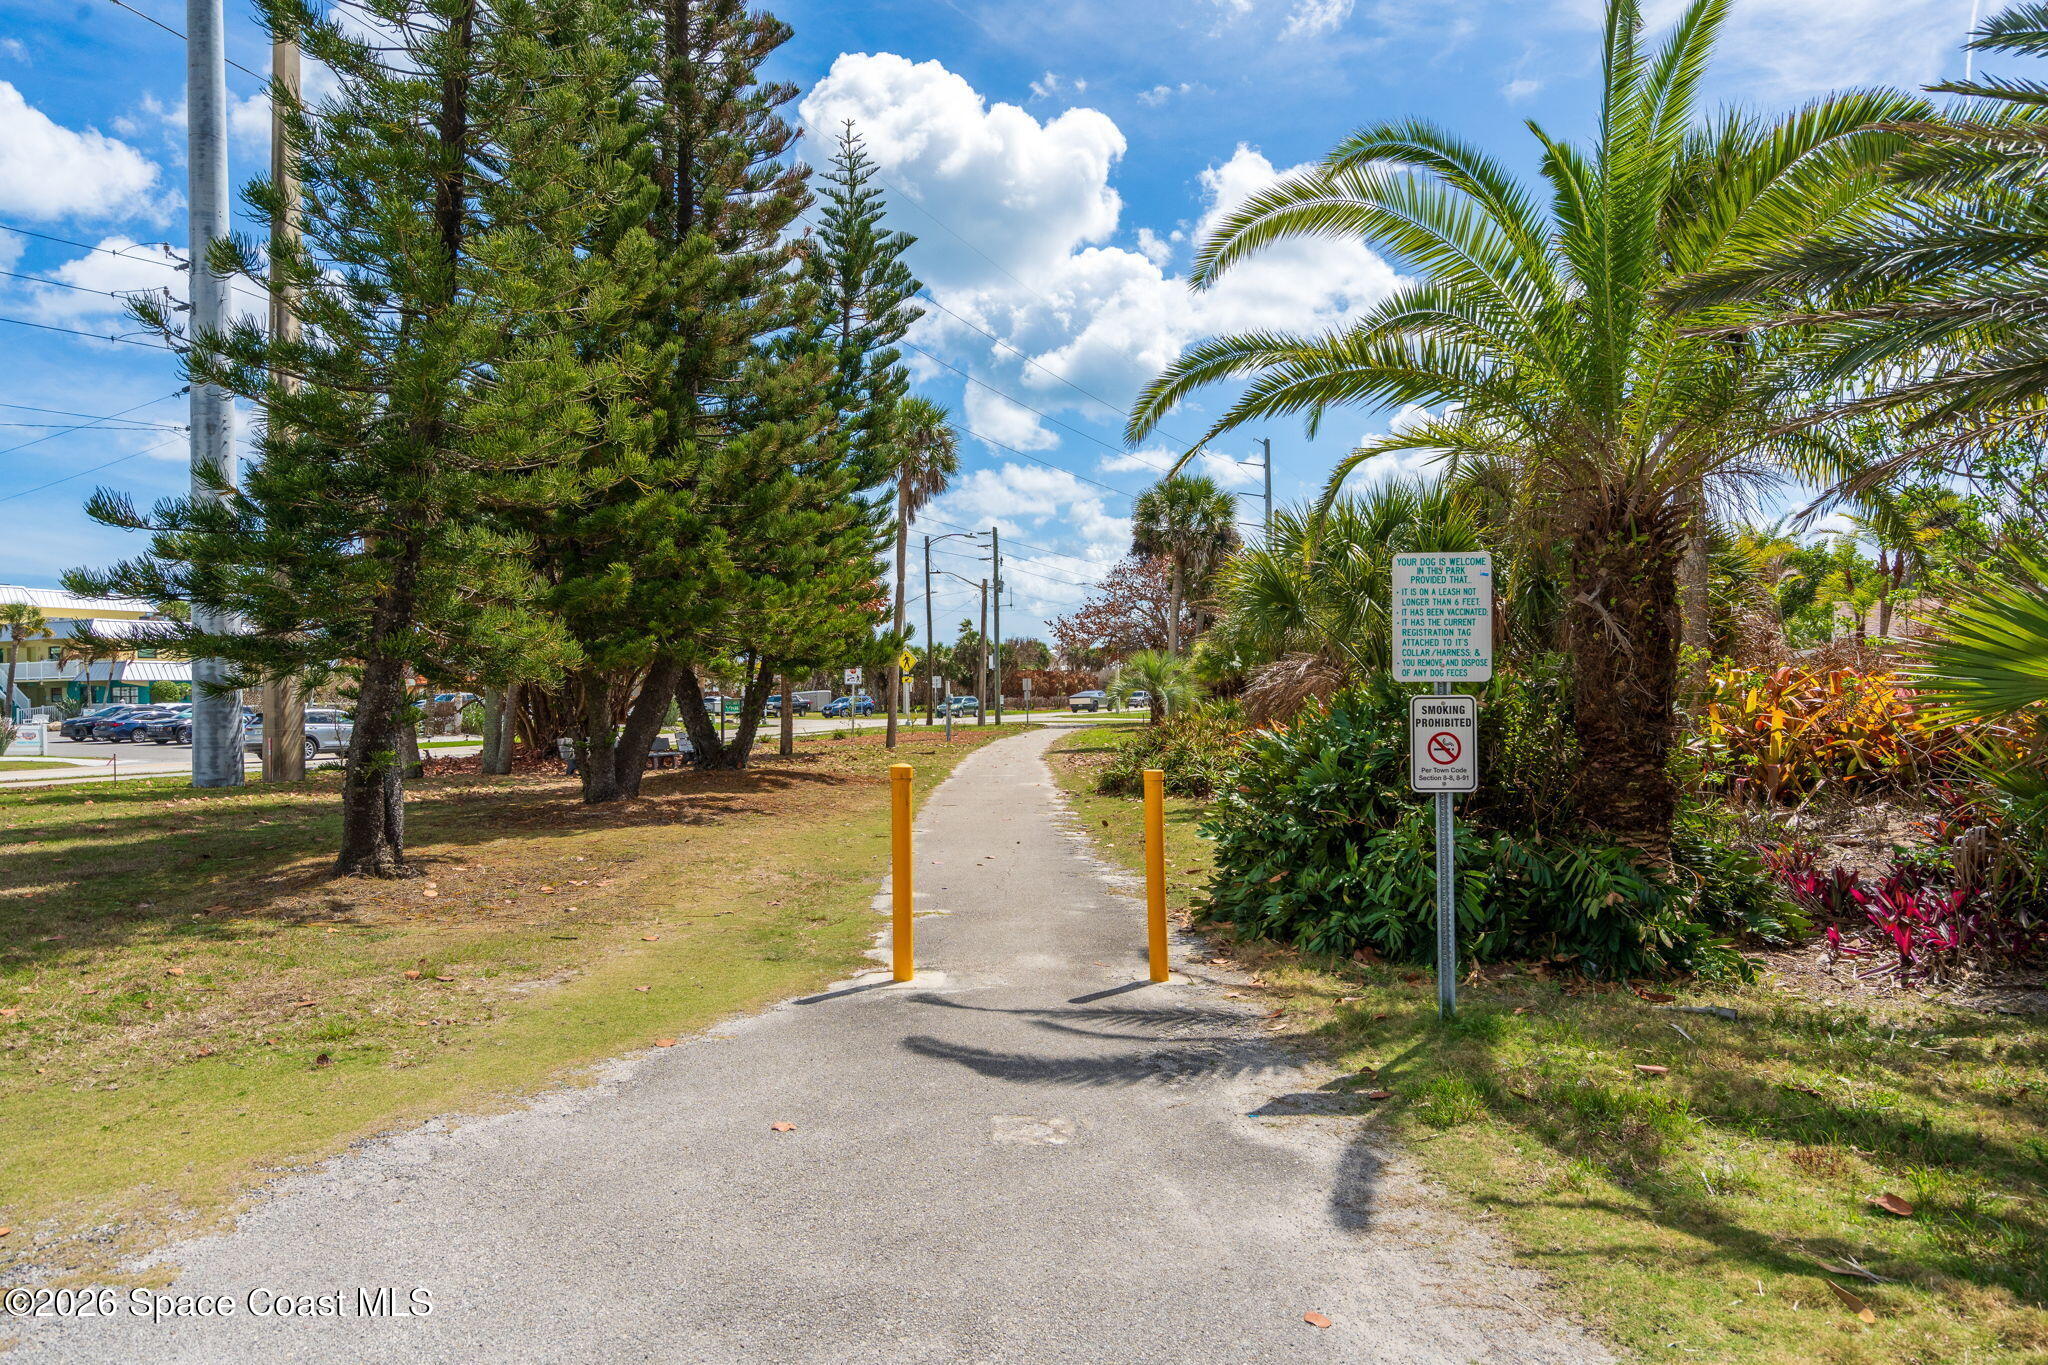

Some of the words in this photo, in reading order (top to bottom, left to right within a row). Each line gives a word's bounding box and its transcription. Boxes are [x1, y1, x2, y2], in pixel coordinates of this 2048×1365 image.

[1397, 558, 1416, 566] YOUR
[1420, 558, 1436, 566] DOG
[1439, 558, 1446, 566] IS
[1450, 558, 1486, 566] WELCOME
[1422, 706, 1465, 714] SMOKING
[1416, 718, 1471, 727] PROHIBITED
